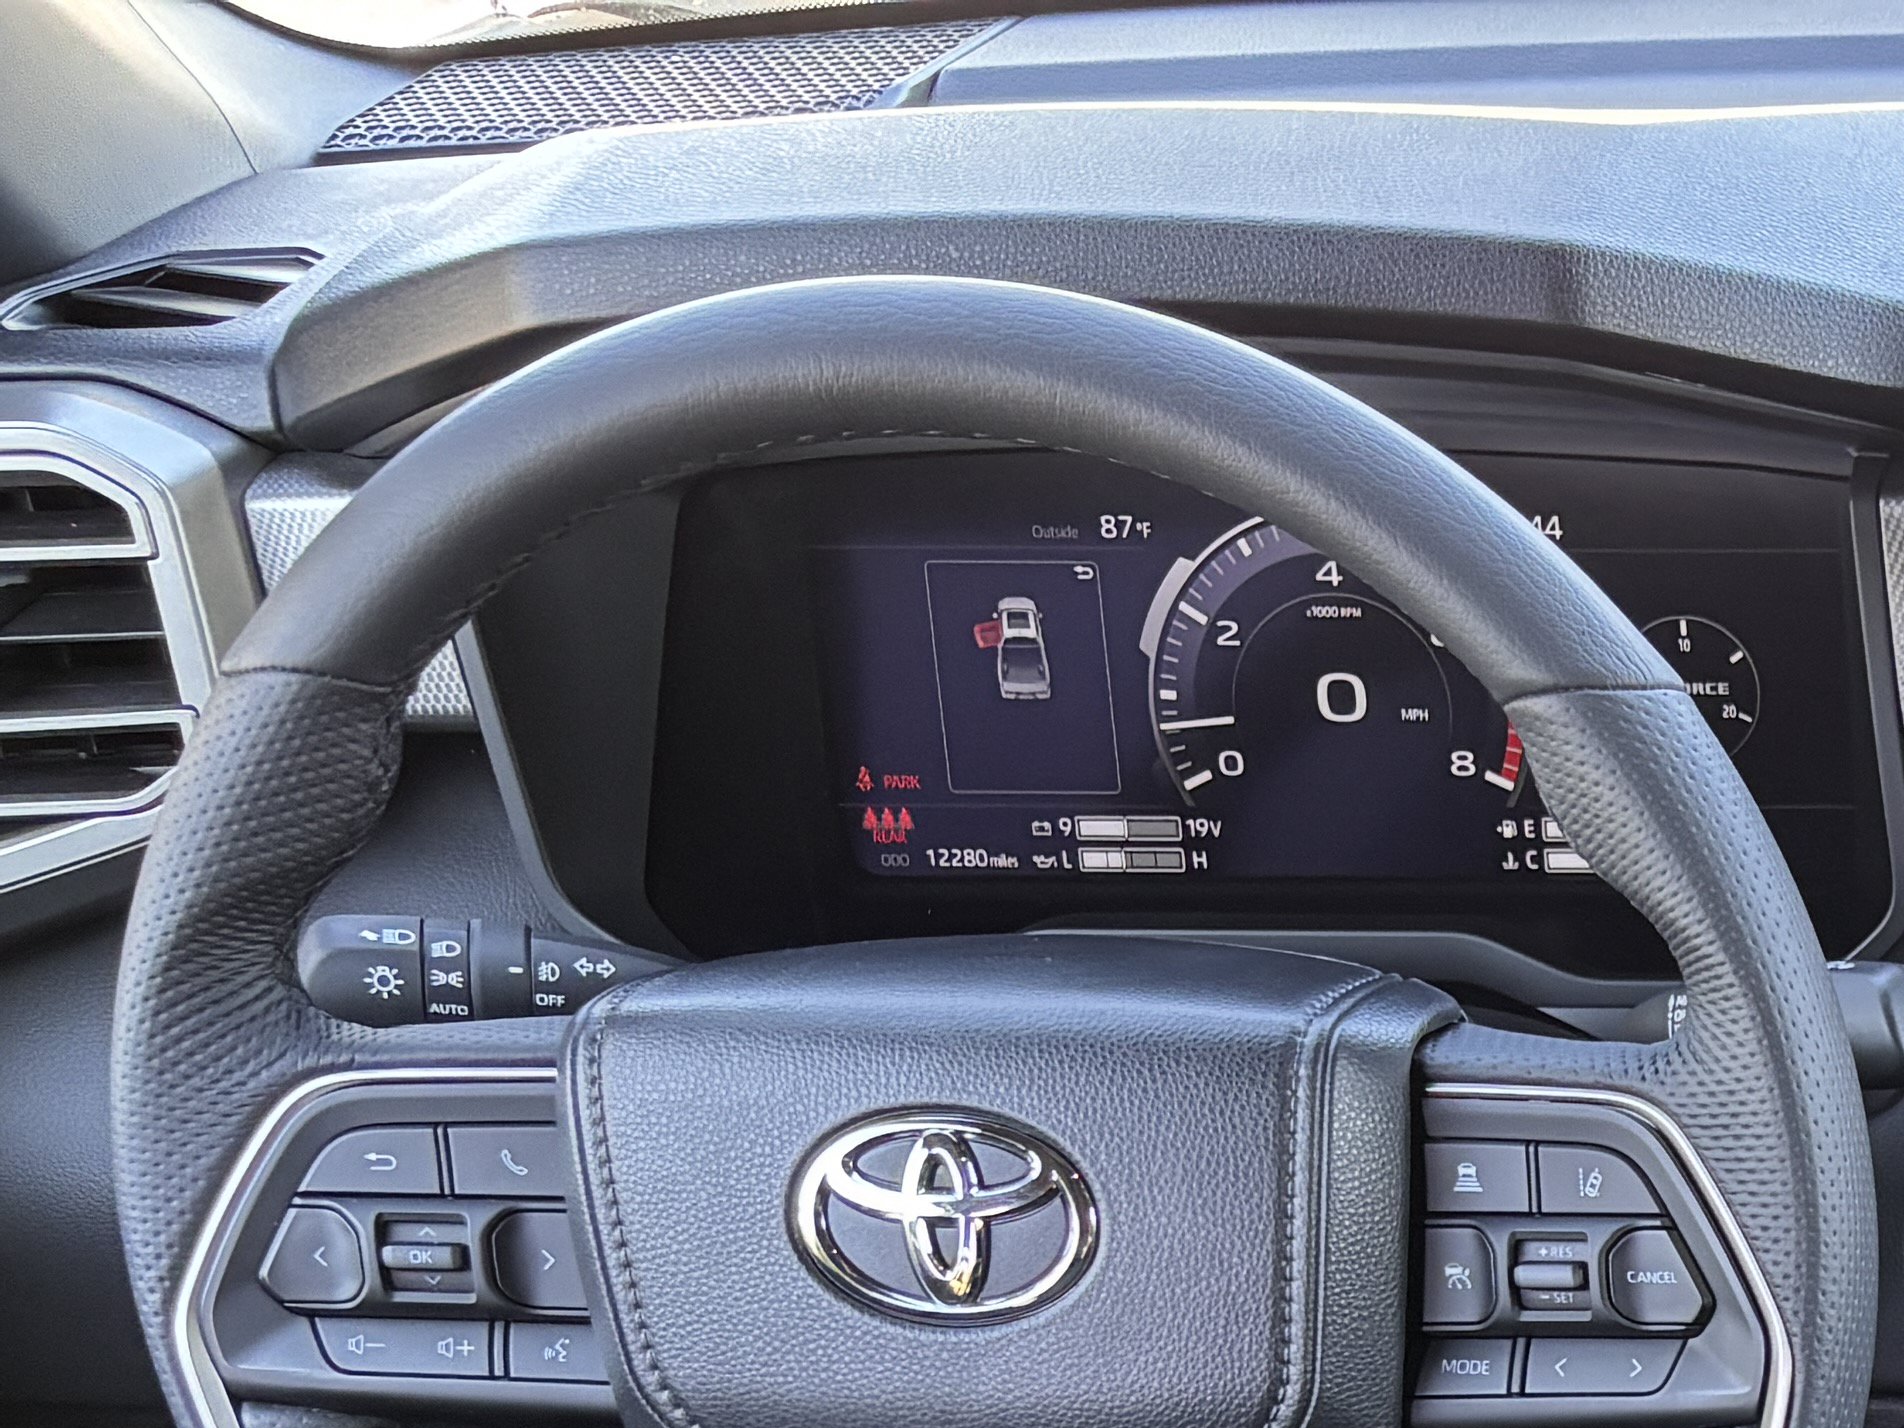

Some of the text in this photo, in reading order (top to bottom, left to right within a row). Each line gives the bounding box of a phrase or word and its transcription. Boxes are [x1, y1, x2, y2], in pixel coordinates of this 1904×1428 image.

[1031, 524, 1079, 540] Outside
[1315, 560, 1343, 587] 4
[1340, 606, 1362, 619] RPM
[1216, 620, 1241, 647] 2
[1677, 638, 1691, 652] 10
[1316, 672, 1367, 723] 0
[1401, 708, 1429, 722] MPH
[1722, 704, 1737, 719] 20
[1218, 750, 1244, 777] 0
[1450, 750, 1477, 777] 8
[883, 774, 921, 790] PARK
[1058, 818, 1222, 839] 9 19V
[1523, 819, 1536, 839] E
[1061, 850, 1208, 870] L H
[1525, 850, 1539, 870] C
[429, 1002, 469, 1016] AUTO
[535, 993, 566, 1008] OFF
[408, 1249, 433, 1264] OK
[1627, 1269, 1678, 1285] CANCEL
[1441, 1357, 1491, 1376] MODE
